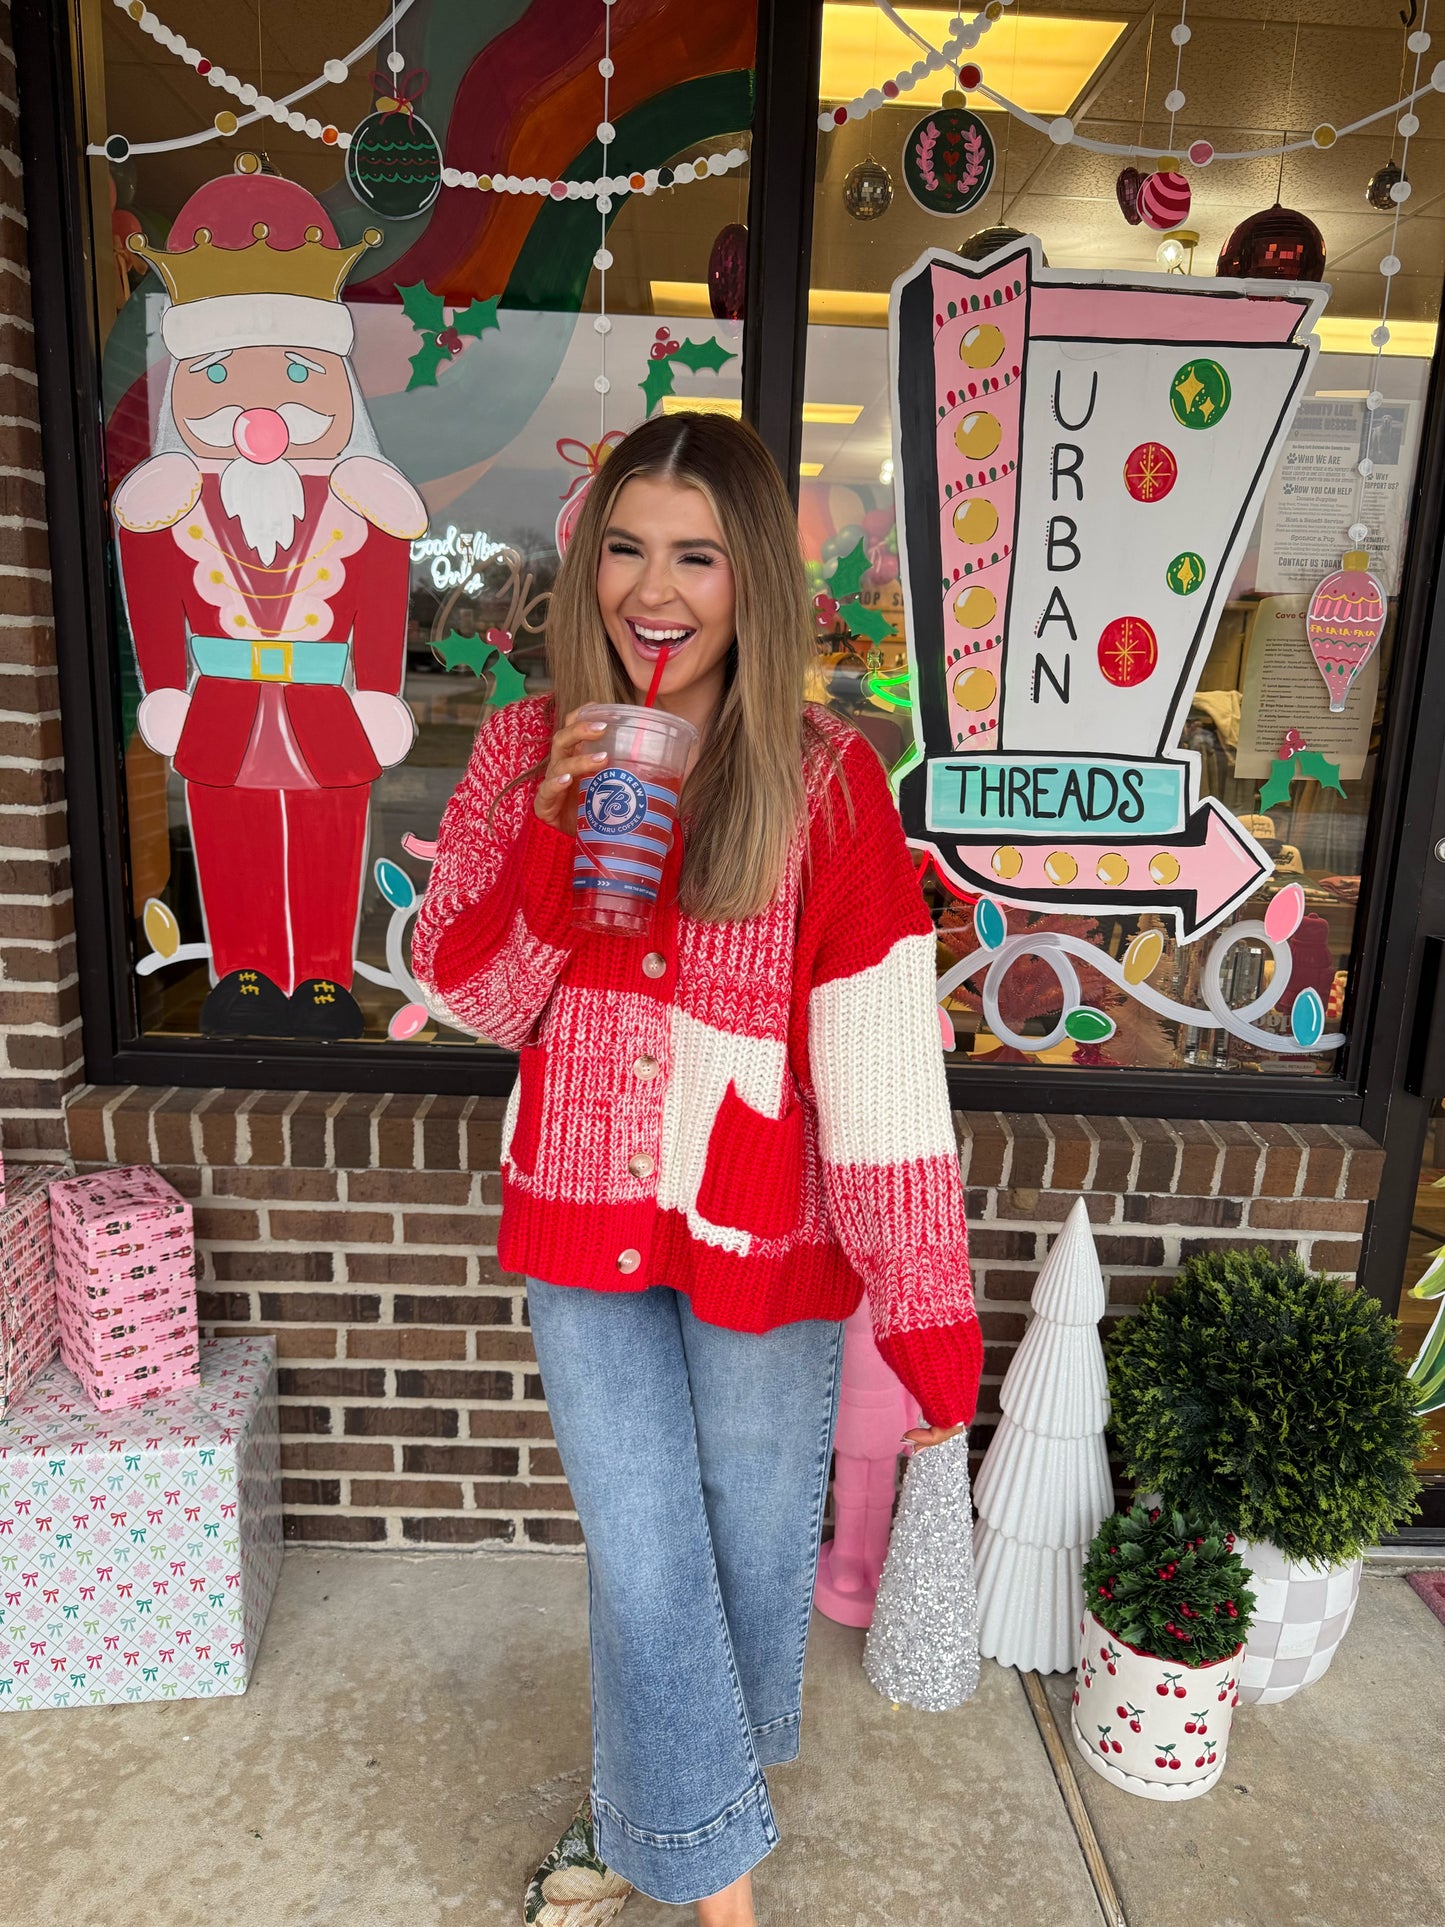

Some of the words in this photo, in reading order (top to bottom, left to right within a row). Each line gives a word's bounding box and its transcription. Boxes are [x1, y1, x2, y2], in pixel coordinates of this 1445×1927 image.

[1328, 456, 1341, 465] ARE
[1293, 485, 1309, 494] HOW
[1310, 486, 1323, 495] YOU
[1324, 486, 1336, 495] CAN
[1337, 487, 1352, 496] HELP
[1030, 370, 1098, 704] URBAN
[1278, 557, 1308, 567] CONTACT
[1309, 558, 1319, 567] US
[1275, 611, 1296, 619] Cave
[590, 770, 616, 793] SEVEN
[620, 772, 645, 797] BREW
[945, 765, 1144, 824] THREADS
[586, 810, 599, 828] DRIVE
[599, 825, 616, 833] THRU
[617, 814, 642, 832] COFFEE
